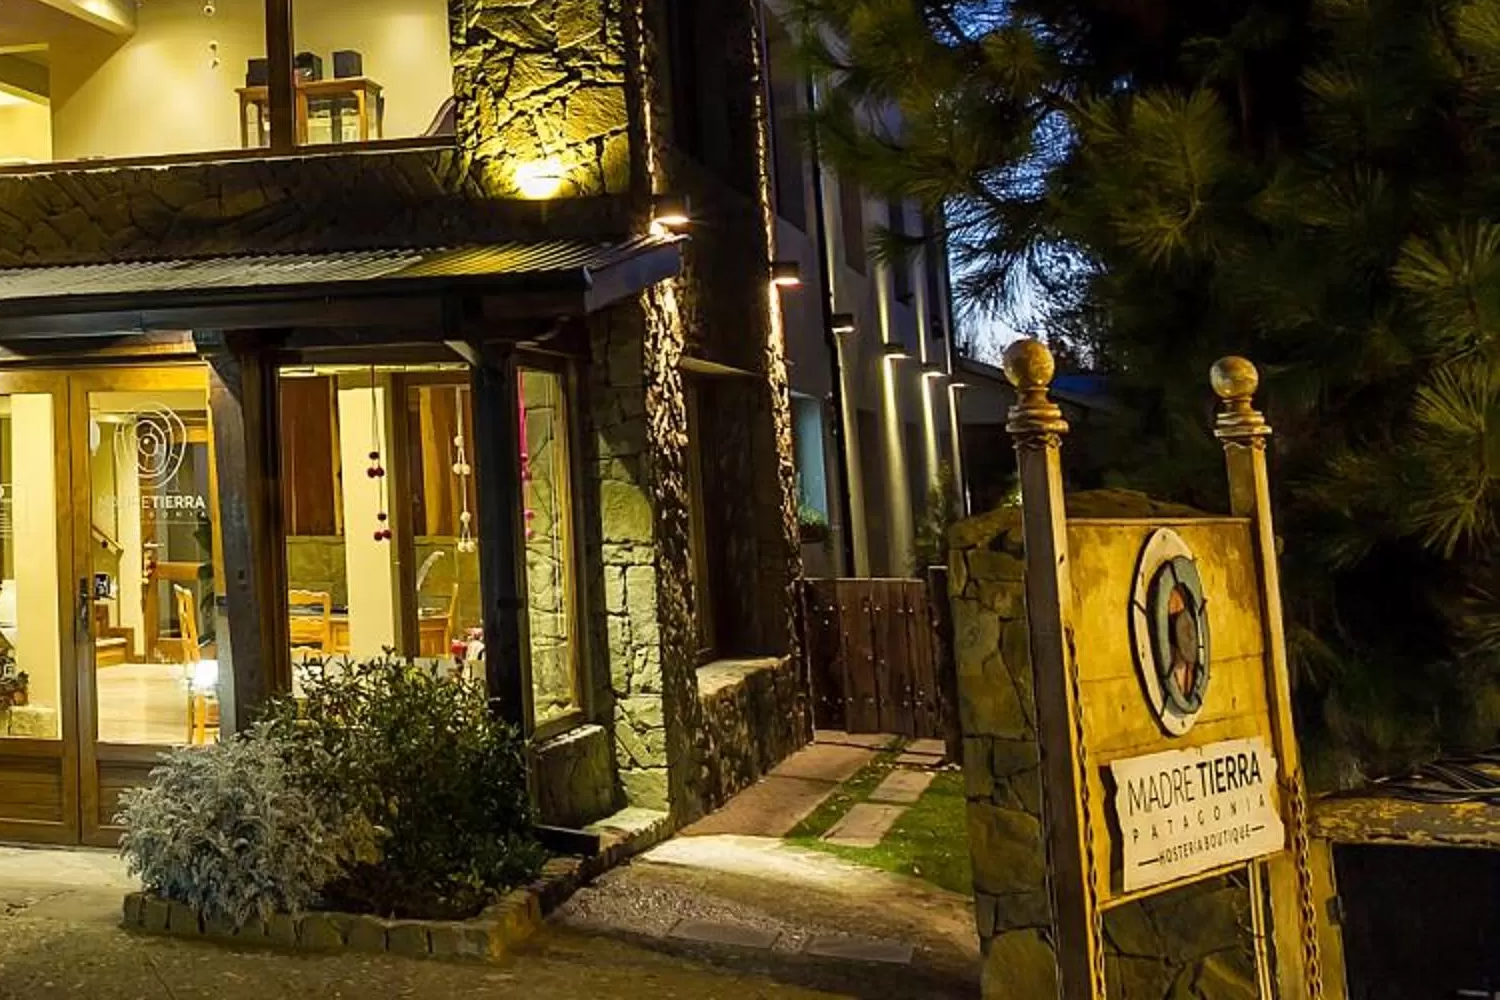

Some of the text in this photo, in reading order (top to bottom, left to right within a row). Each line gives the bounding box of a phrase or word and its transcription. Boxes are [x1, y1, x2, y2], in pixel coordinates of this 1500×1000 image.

[152, 495, 206, 509] TIERRA
[1127, 751, 1262, 816] MADRE TIERRA
[1133, 794, 1265, 844] PATAGONIA
[1203, 823, 1250, 850] BOUTIQUE
